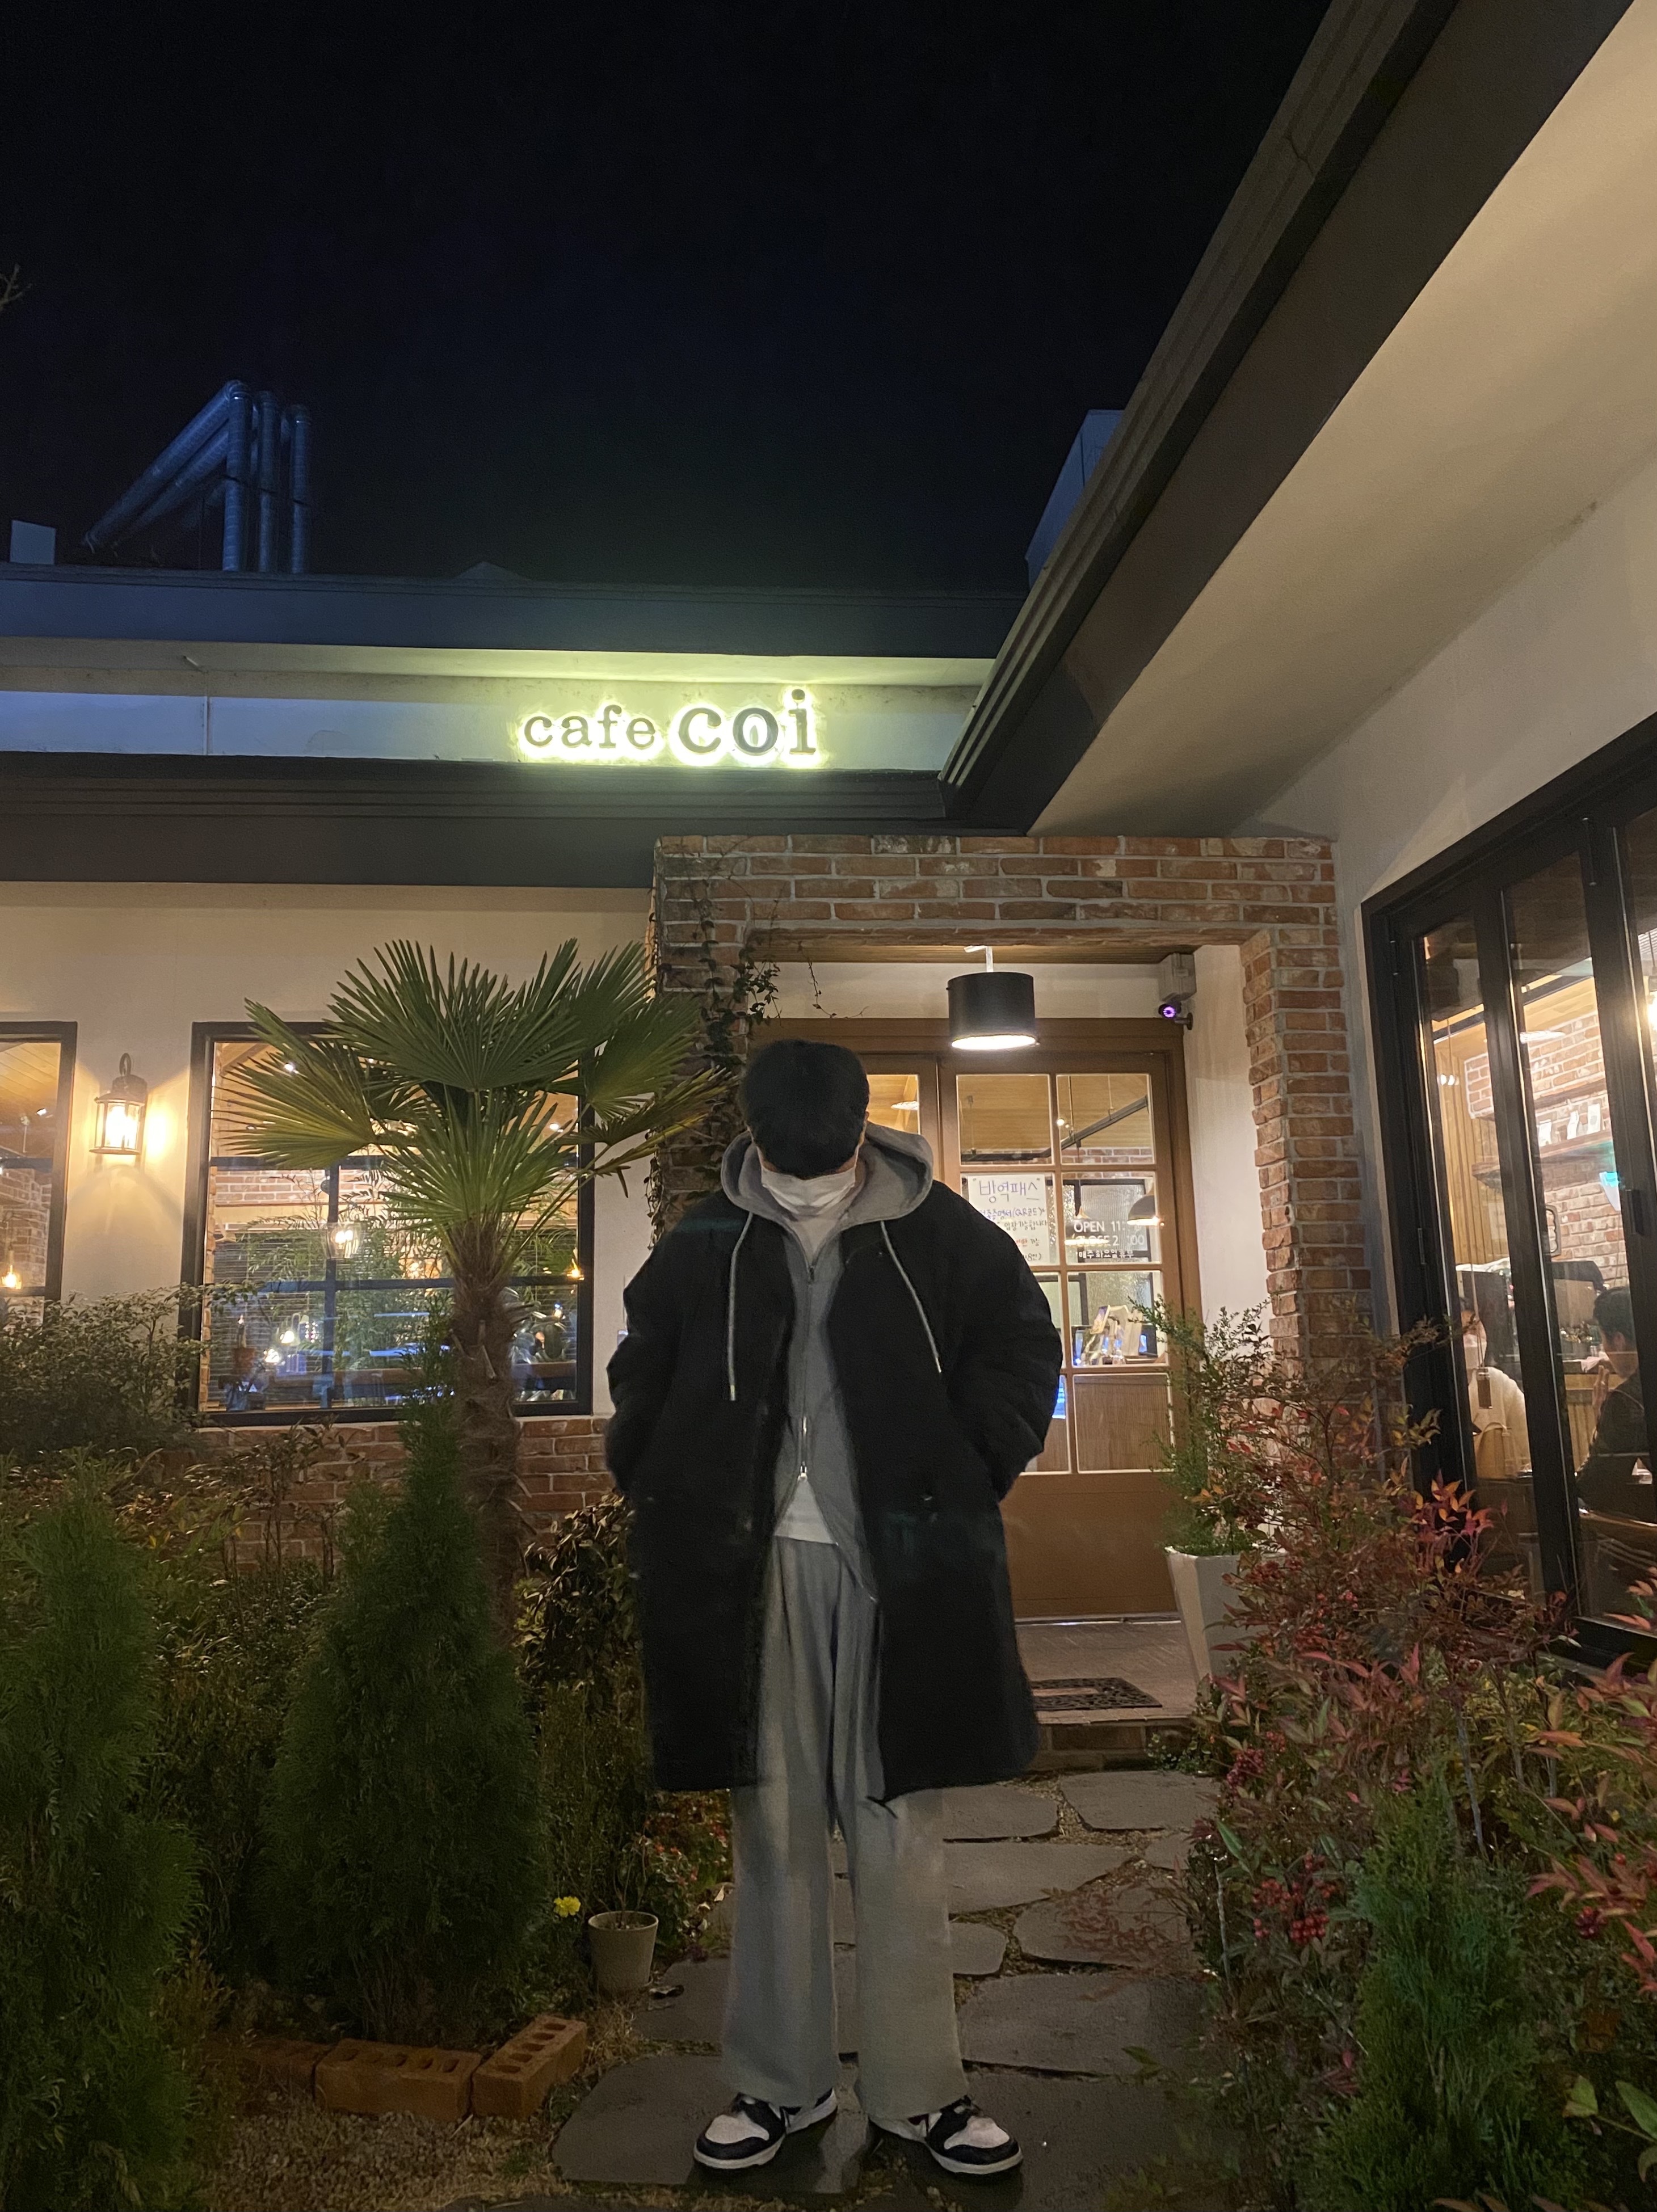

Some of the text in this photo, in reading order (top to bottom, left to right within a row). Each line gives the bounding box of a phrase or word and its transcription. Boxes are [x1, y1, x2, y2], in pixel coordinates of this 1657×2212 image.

[524, 688, 817, 755] cafe coi
[1074, 1220, 1105, 1233] OPEN
[1075, 1235, 1111, 1246] COSE
[1096, 1249, 1117, 1258] 화요일
